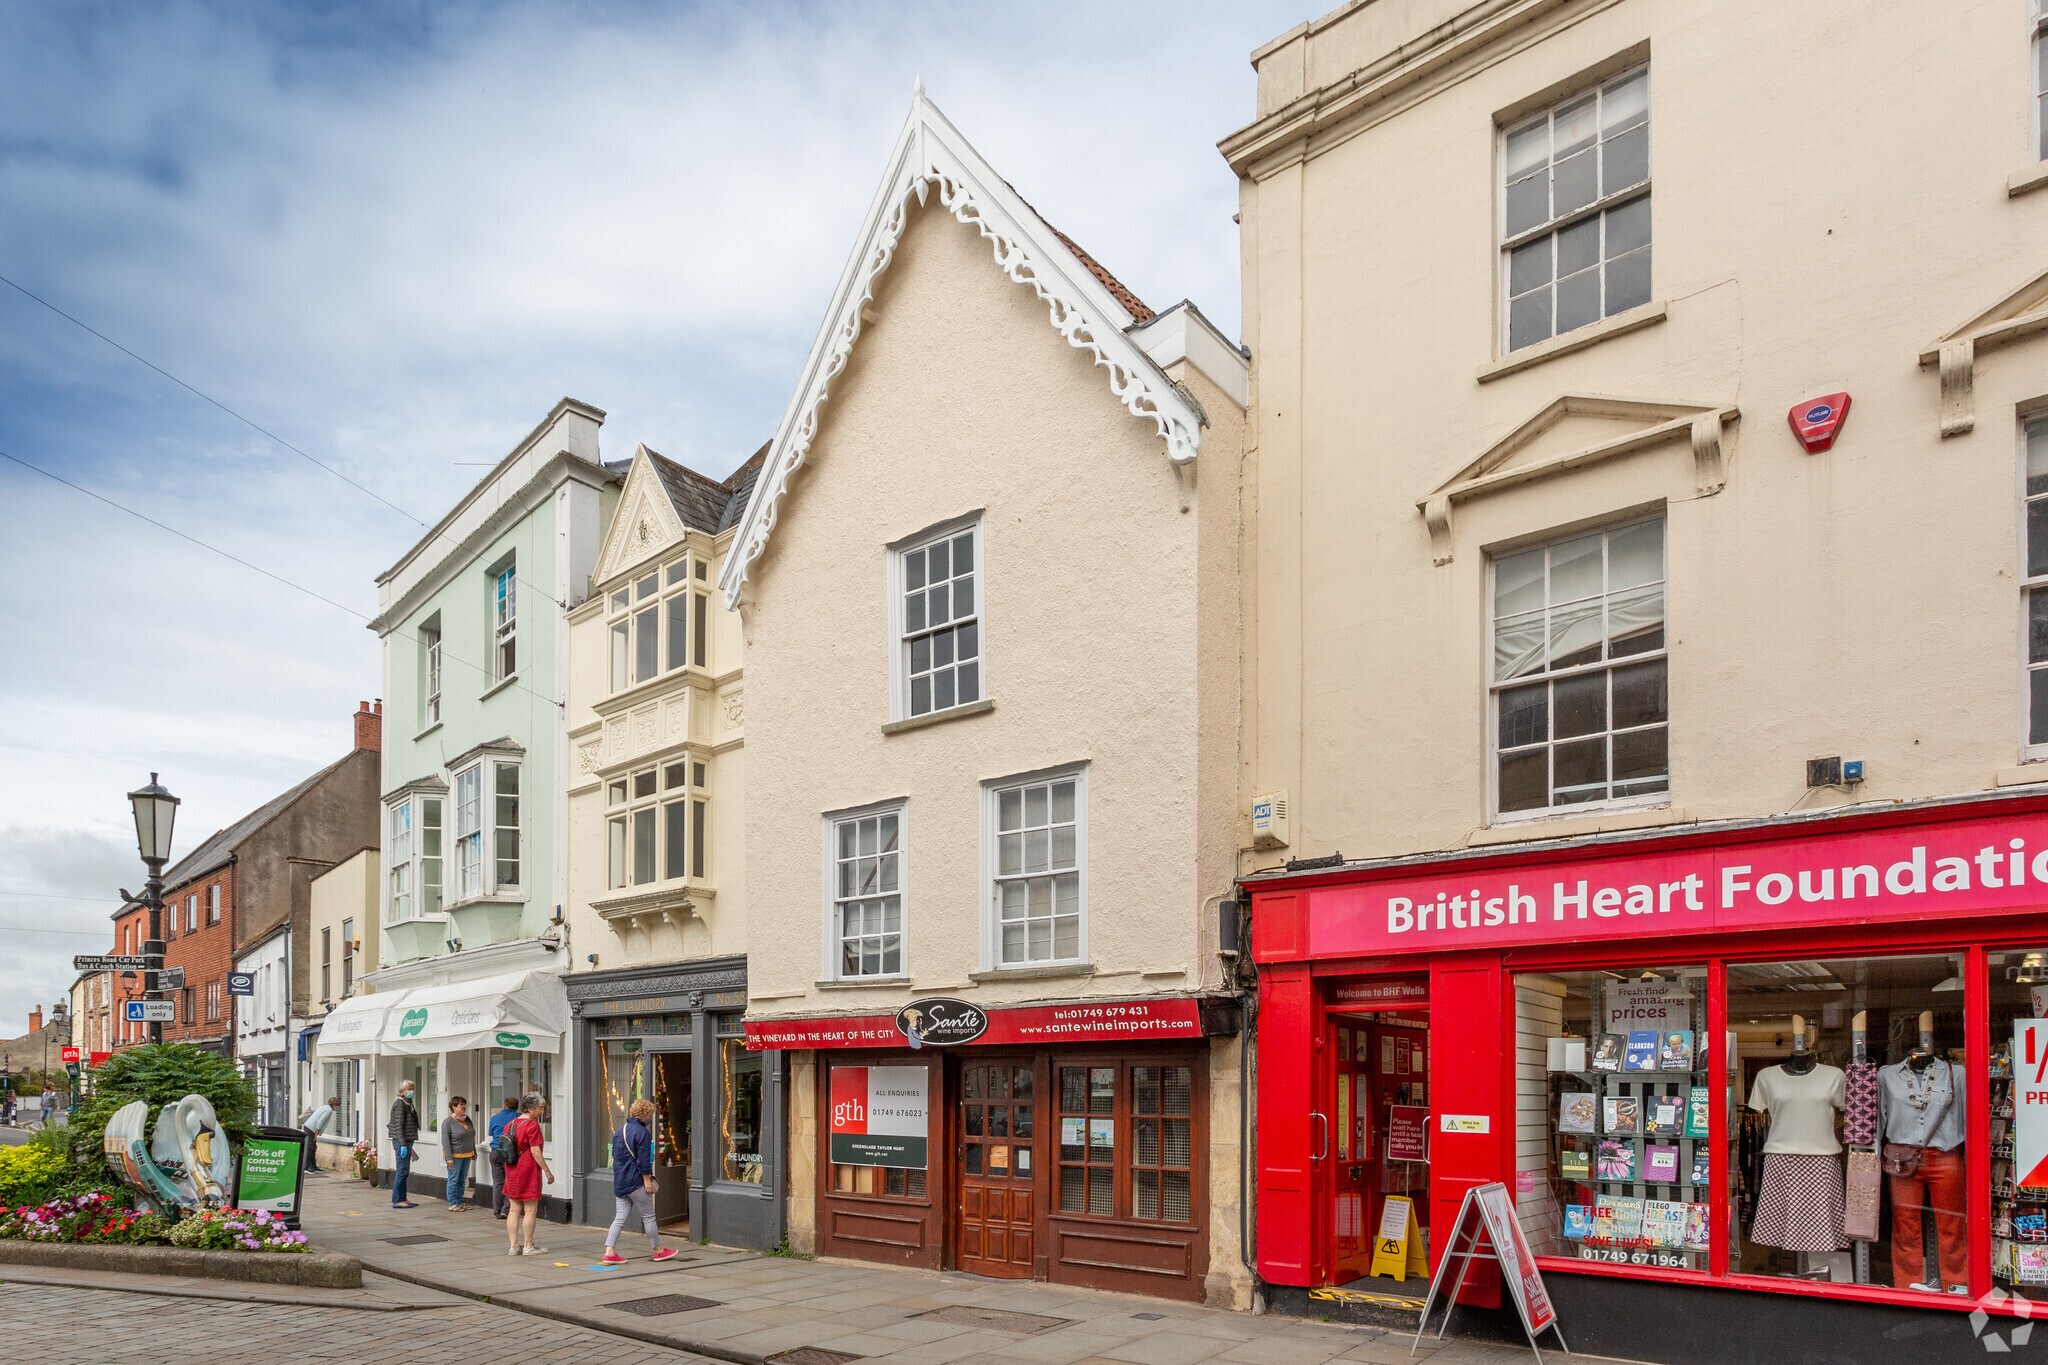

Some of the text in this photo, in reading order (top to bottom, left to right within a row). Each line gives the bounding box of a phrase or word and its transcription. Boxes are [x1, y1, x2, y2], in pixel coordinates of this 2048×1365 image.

[1808, 409, 1829, 419] FUTURE
[1256, 806, 1271, 816] ADT
[1387, 883, 1537, 934] British
[1553, 872, 1705, 921] Heart
[119, 955, 131, 963] Car
[716, 990, 746, 1005] No 58
[1337, 986, 1425, 998] Welcome to BHF Wells
[604, 997, 667, 1013] THE LAUNDRY
[450, 1010, 481, 1026] Opticians
[928, 1005, 980, 1031] Santé
[1055, 1006, 1149, 1019] tel:01749 679 431
[1611, 1006, 1667, 1023] prices
[402, 1016, 426, 1030] Specsavers
[1020, 1018, 1193, 1035] www.santewineimports.com
[498, 1034, 529, 1046] Specsavers
[749, 1029, 895, 1043] THE VINEYARD IN THE HEART OF THE CITY
[1628, 1042, 1655, 1050] CLARKSON
[63, 1050, 78, 1059] gth
[2025, 1027, 2048, 1083] 1/
[834, 1098, 864, 1127] gth
[872, 1108, 922, 1117] 01749 676023
[271, 1150, 286, 1158] off
[728, 1152, 763, 1162] THE LAUNDRY
[247, 1158, 285, 1166] contact
[246, 1165, 278, 1173] lenses
[1599, 1198, 1641, 1208] DINOSAURS
[1583, 1206, 1612, 1218] FREE
[1647, 1209, 1679, 1221] IDEAS
[1583, 1235, 1653, 1250] SAVE LIVES!
[1583, 1248, 1688, 1268] 01749 671964
[2022, 1259, 2043, 1269] Sting
[1523, 1272, 1541, 1299] SALE
